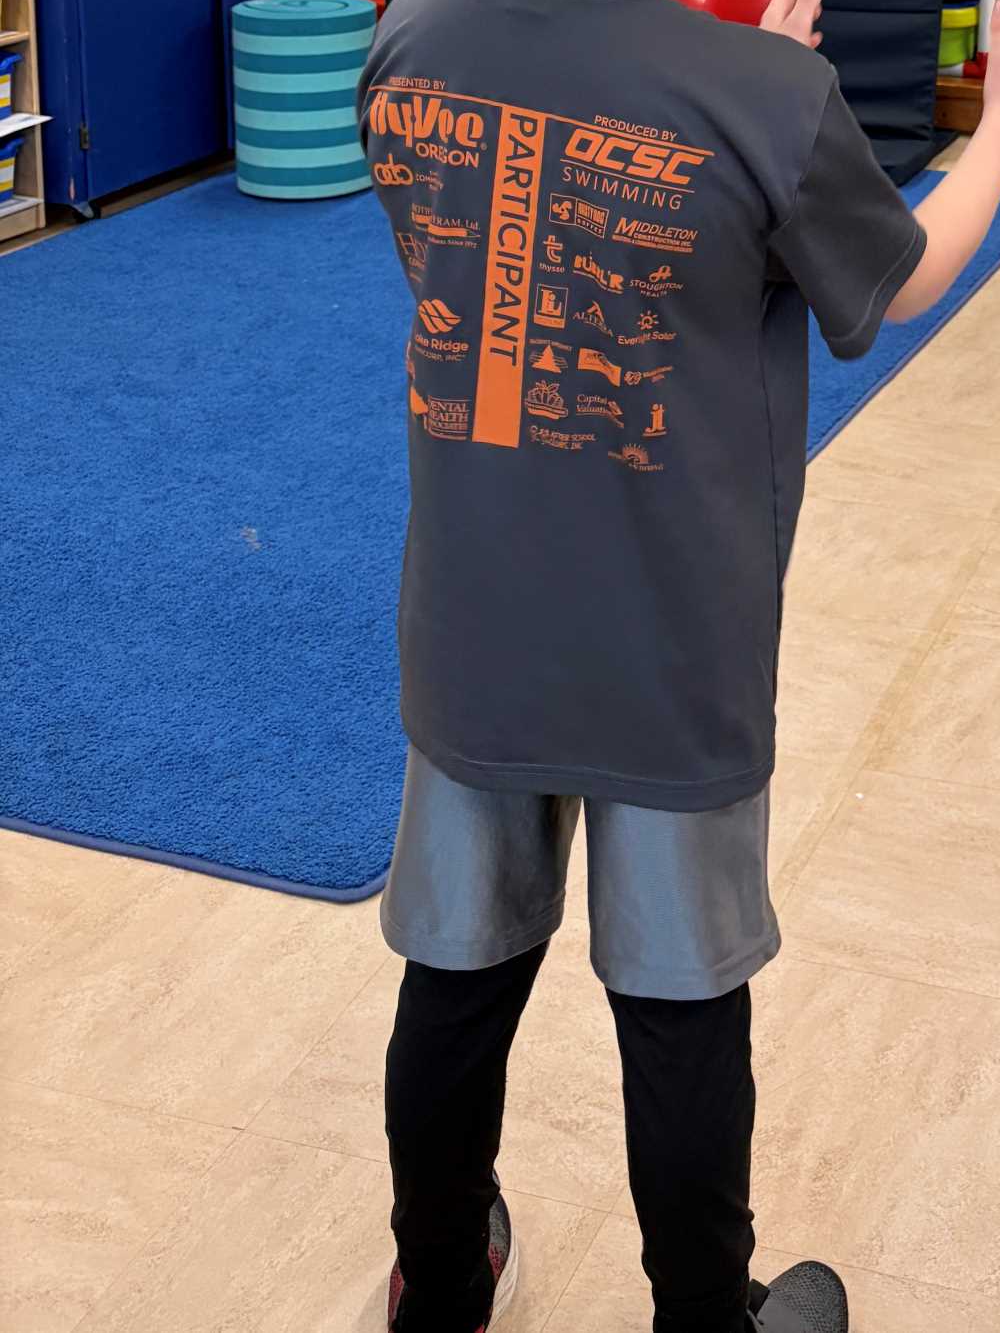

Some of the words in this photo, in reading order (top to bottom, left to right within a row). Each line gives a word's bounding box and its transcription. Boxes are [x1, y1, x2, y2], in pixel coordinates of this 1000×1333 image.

[433, 80, 446, 90] BY
[594, 115, 658, 138] PRODUCED
[661, 130, 677, 142] BY
[415, 142, 480, 168] OREGON
[564, 128, 705, 185] OCSC
[562, 166, 682, 210] SWIMMING
[490, 113, 538, 367] PARTICIPANT
[614, 217, 698, 241] MIDDLETON
[629, 279, 684, 291] STOUGHTON
[431, 338, 469, 352] Ridge
